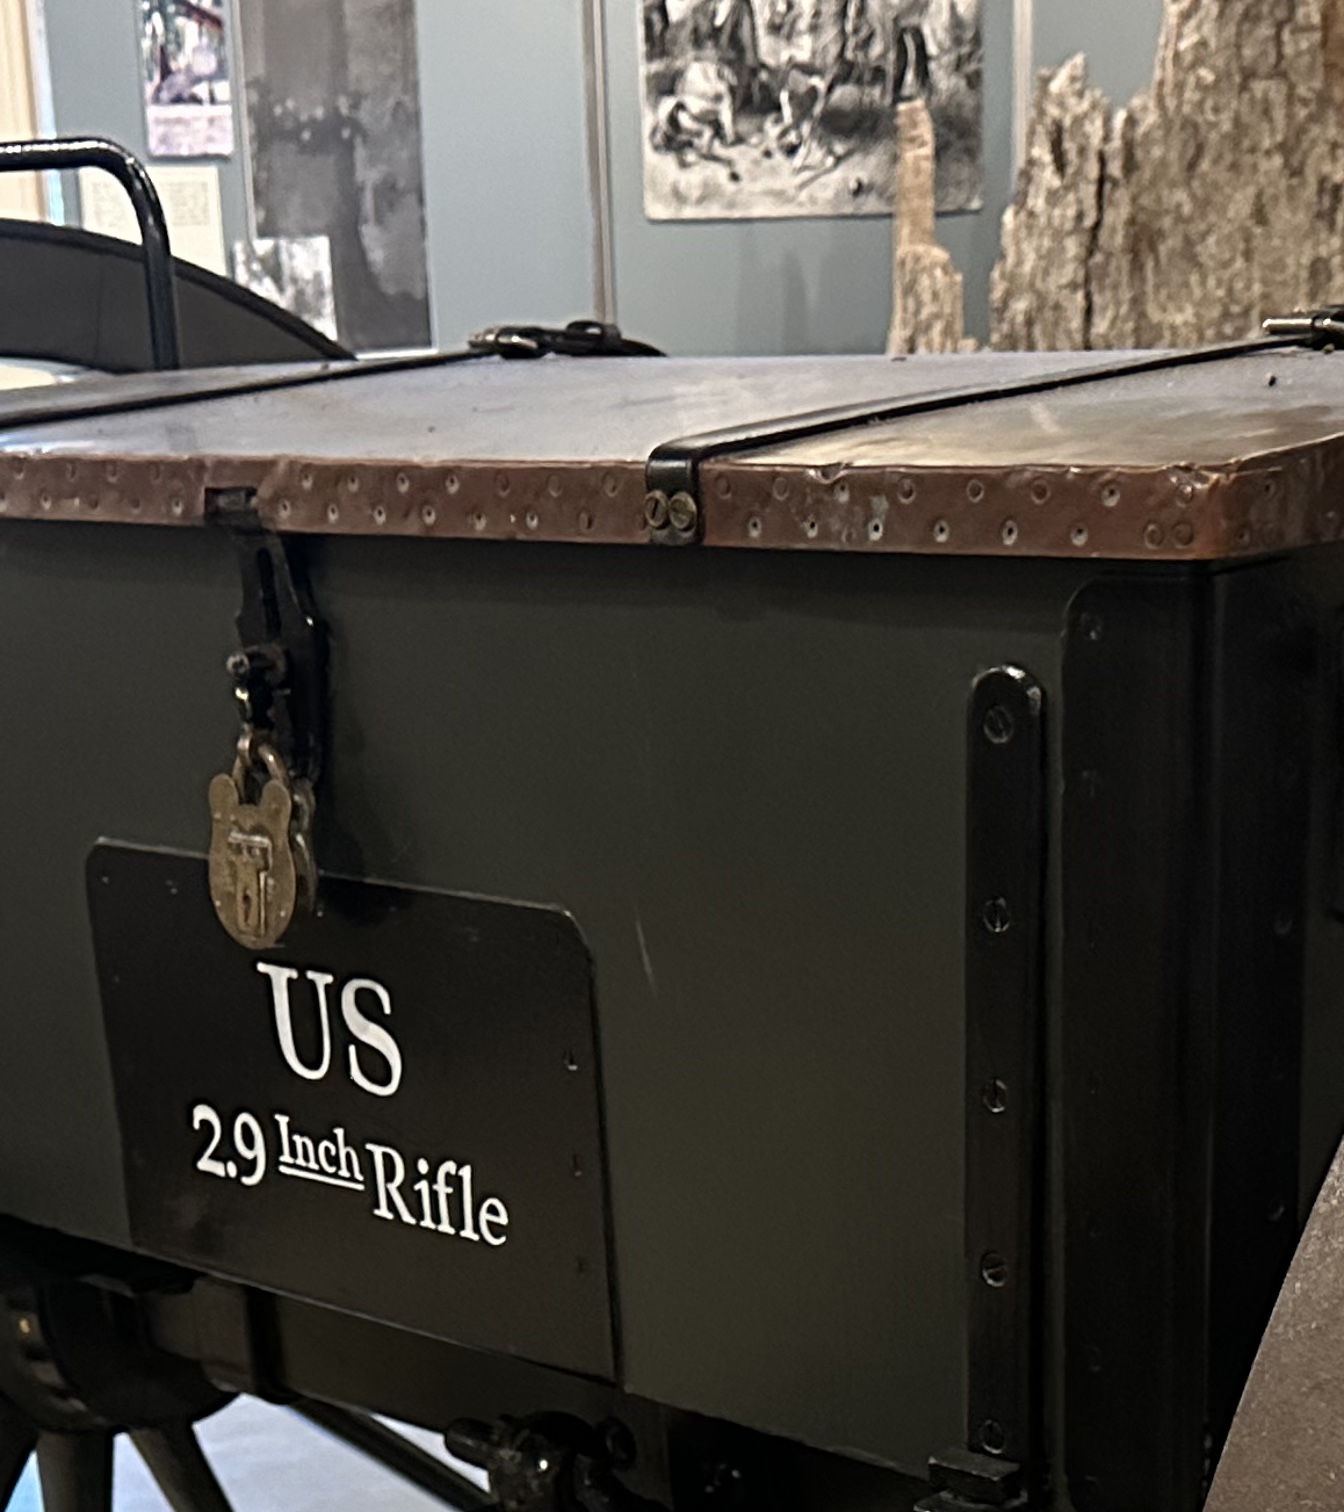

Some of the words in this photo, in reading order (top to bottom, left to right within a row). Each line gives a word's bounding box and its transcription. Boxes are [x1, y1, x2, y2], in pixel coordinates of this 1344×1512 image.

[256, 961, 402, 1097] US
[192, 1104, 267, 1186] 2.9
[273, 1113, 366, 1184] Inch
[364, 1142, 509, 1246] Rifle
